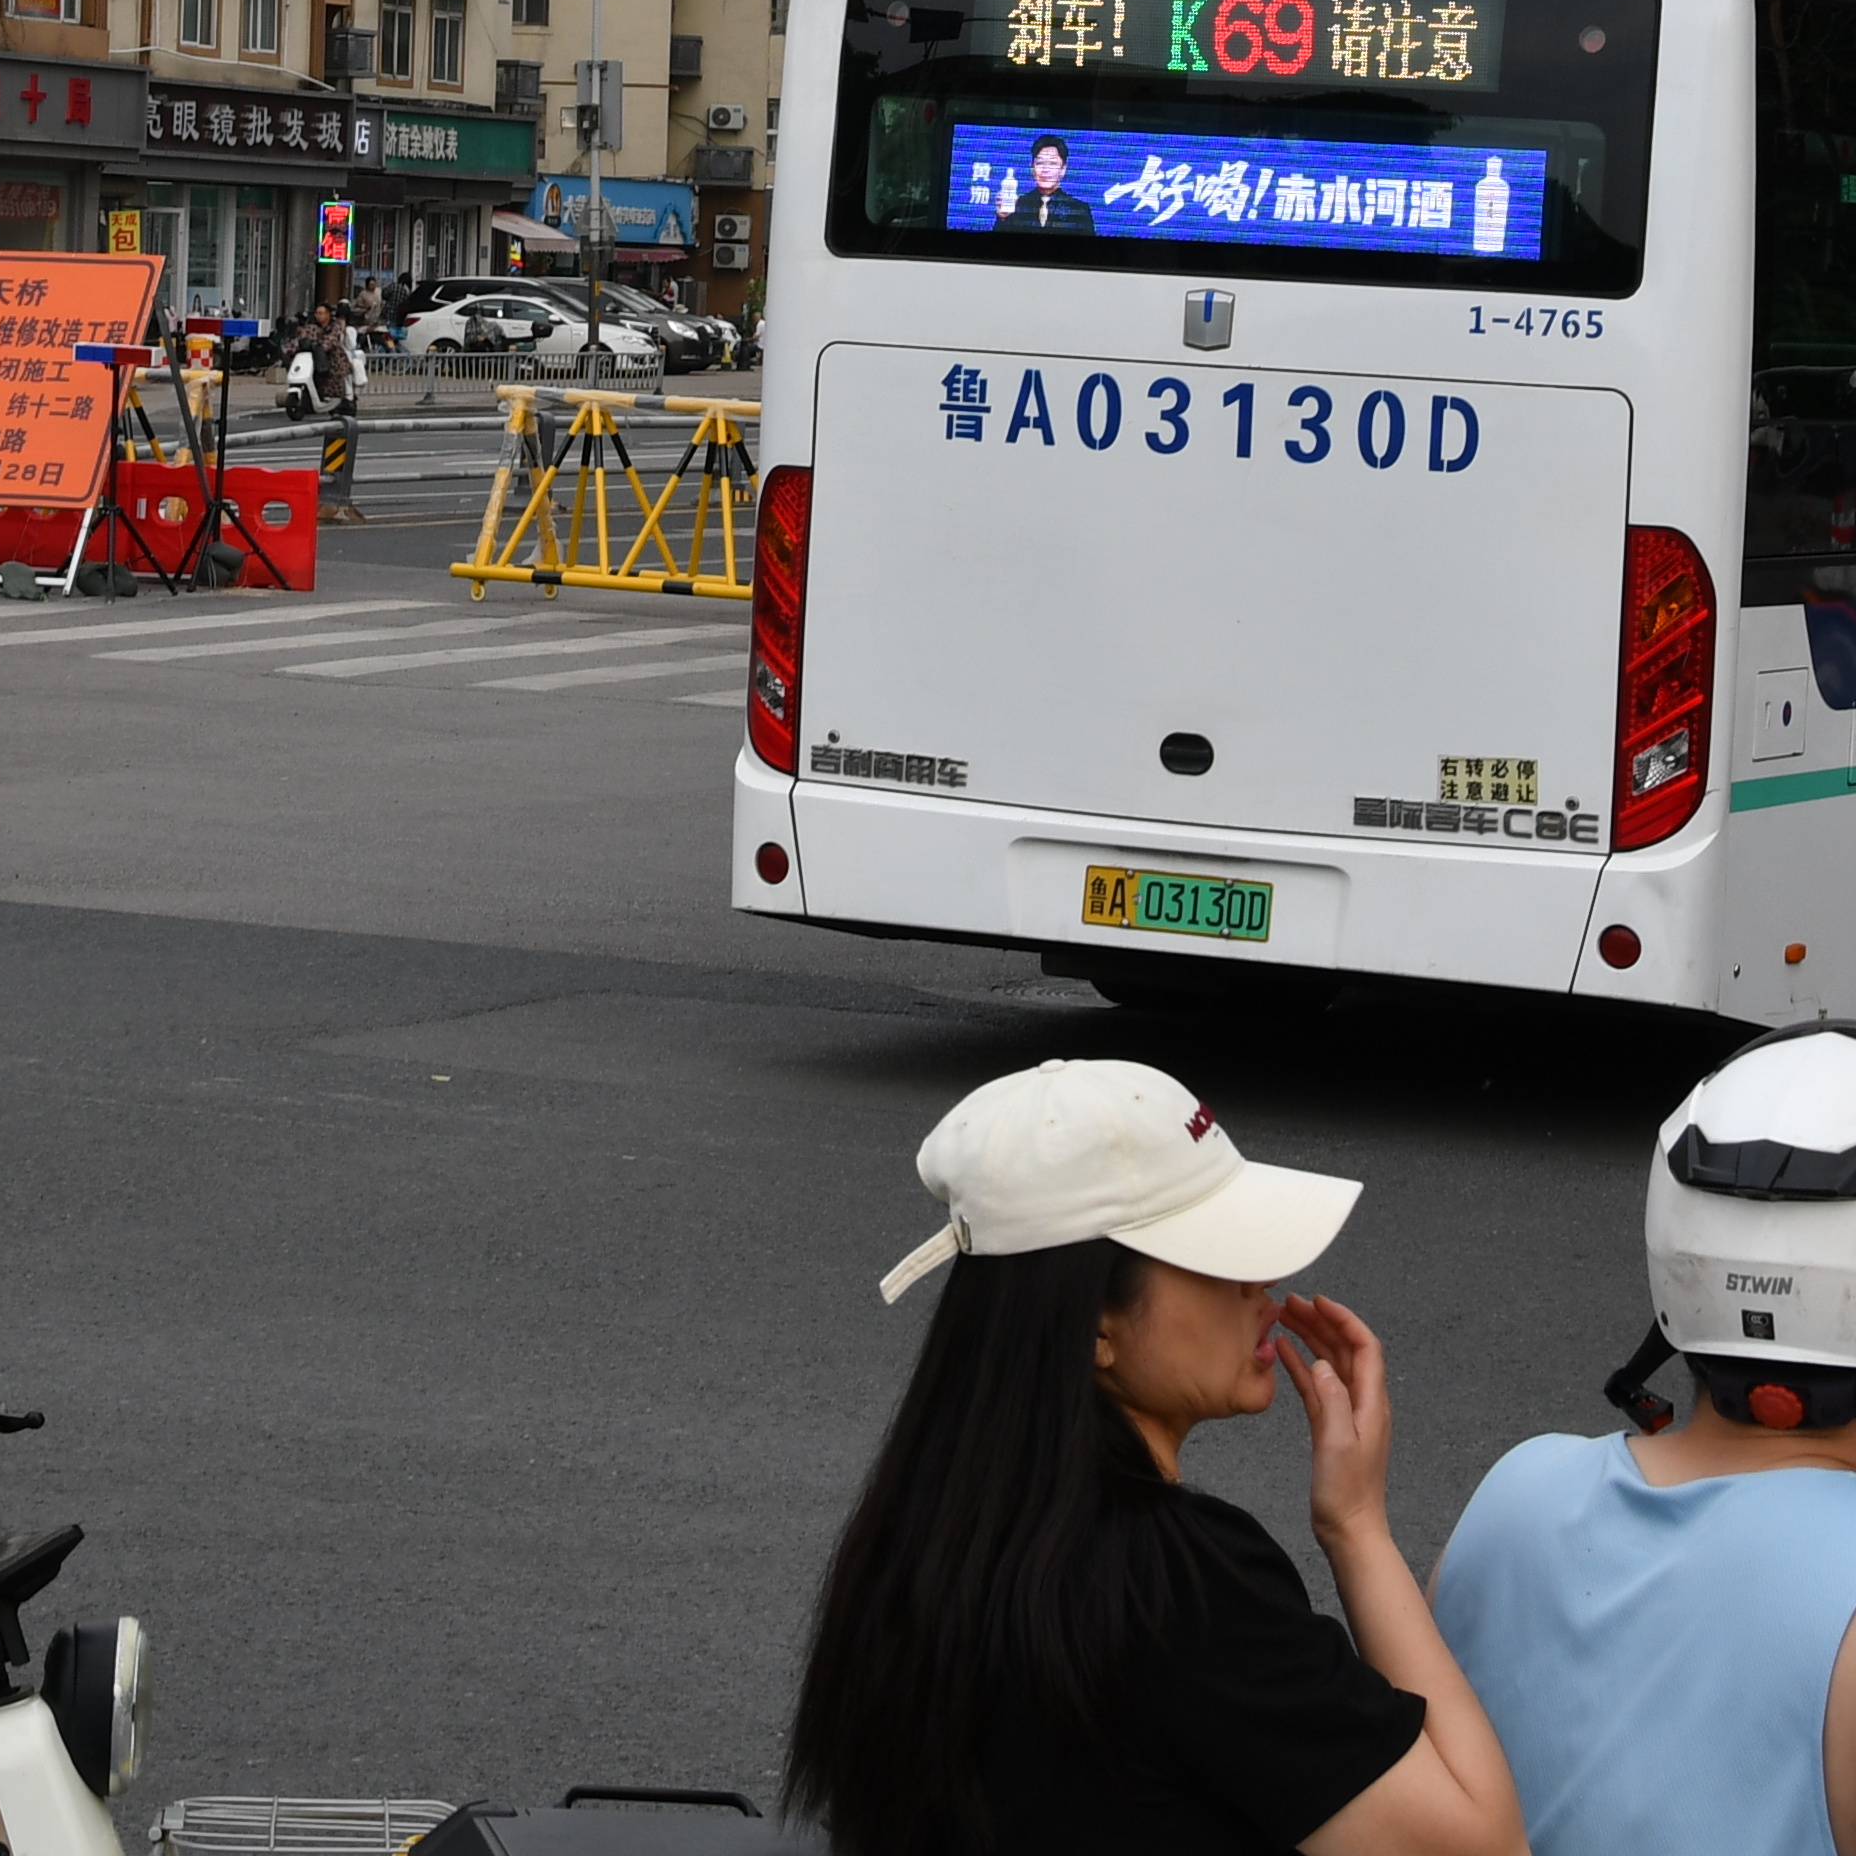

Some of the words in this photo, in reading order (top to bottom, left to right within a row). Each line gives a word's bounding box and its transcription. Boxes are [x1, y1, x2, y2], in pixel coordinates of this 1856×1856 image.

[354, 118, 371, 155] 店
[386, 122, 458, 161] 济南余姚仪表
[1275, 173, 1454, 230] 赤水河酒
[112, 227, 137, 252] 包
[1467, 305, 1605, 341] 1-4765
[939, 363, 1481, 474] 鲁A03130D
[809, 744, 968, 789] 吉利商用车
[1440, 757, 1537, 781] 右转必停
[1440, 780, 1537, 803] 注意避让
[1089, 875, 1267, 932] 鲁A03130D
[1725, 1272, 1794, 1296] ST.WIN
